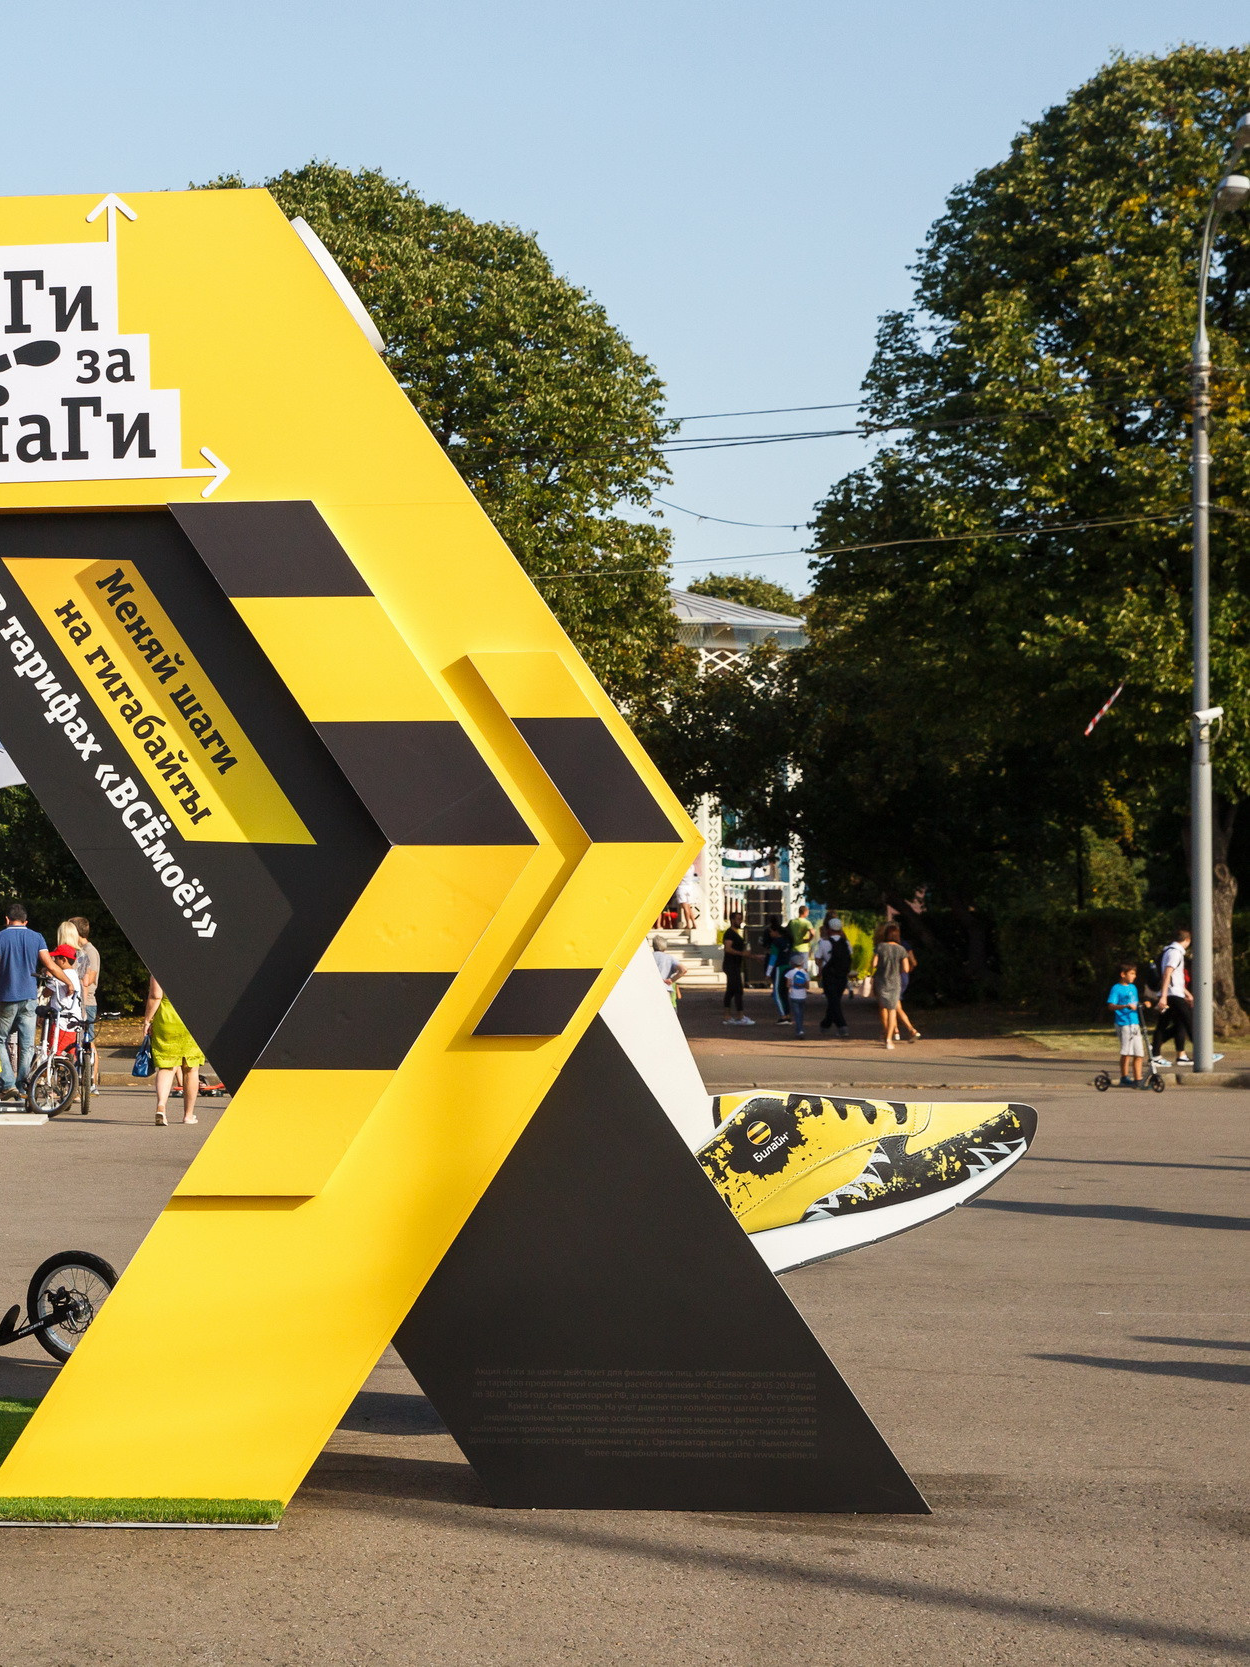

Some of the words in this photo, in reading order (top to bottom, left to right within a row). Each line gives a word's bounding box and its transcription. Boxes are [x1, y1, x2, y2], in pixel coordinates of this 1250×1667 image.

[76, 349, 135, 384] за
[54, 599, 93, 645] на
[84, 645, 211, 825] гигабайты
[96, 567, 185, 685] Меняй
[169, 683, 238, 776] шаги
[0, 616, 102, 762] тарифах
[94, 764, 218, 938] «ВСЁмоё!»
[752, 1133, 790, 1162] Билайн
